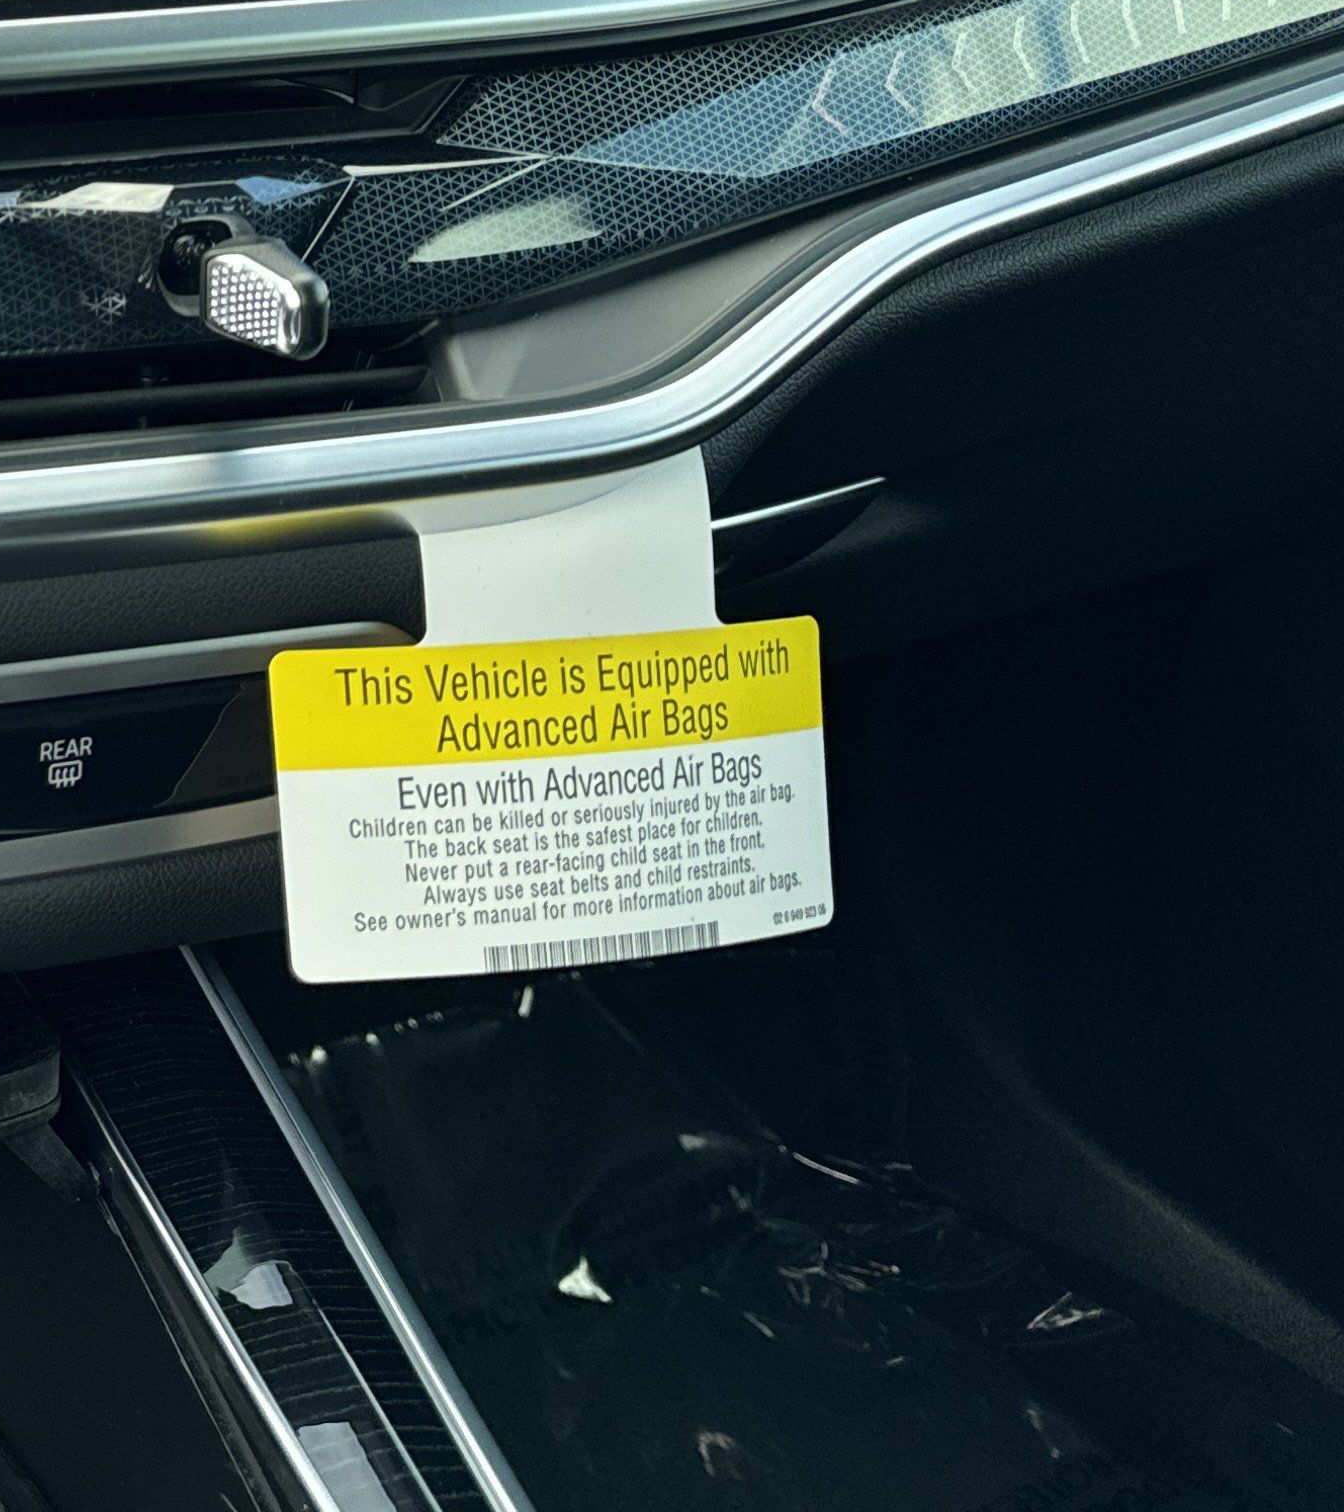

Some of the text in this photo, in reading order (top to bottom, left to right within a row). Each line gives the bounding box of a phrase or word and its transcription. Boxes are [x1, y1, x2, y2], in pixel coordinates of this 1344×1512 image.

[335, 638, 790, 706] This Vehicle is Equipped with
[39, 736, 93, 763] REAR
[437, 698, 729, 753] Advanced Air Bags
[398, 751, 762, 810] Even with Advanced Air Bags
[349, 782, 796, 839] Children can be killed or seriously injured by the air bag.
[404, 810, 763, 859] The back seat is the safest place for children.
[405, 862, 458, 883] Never
[465, 859, 494, 883] put
[499, 860, 509, 878] a
[516, 850, 605, 877] rear-facing
[610, 844, 647, 868] child
[652, 841, 683, 863] seat
[687, 839, 700, 859] in
[704, 836, 726, 856] the
[424, 855, 756, 907] Always use seat belts and child restraints.
[354, 870, 802, 932] See owner's manual for more information about air bags.
